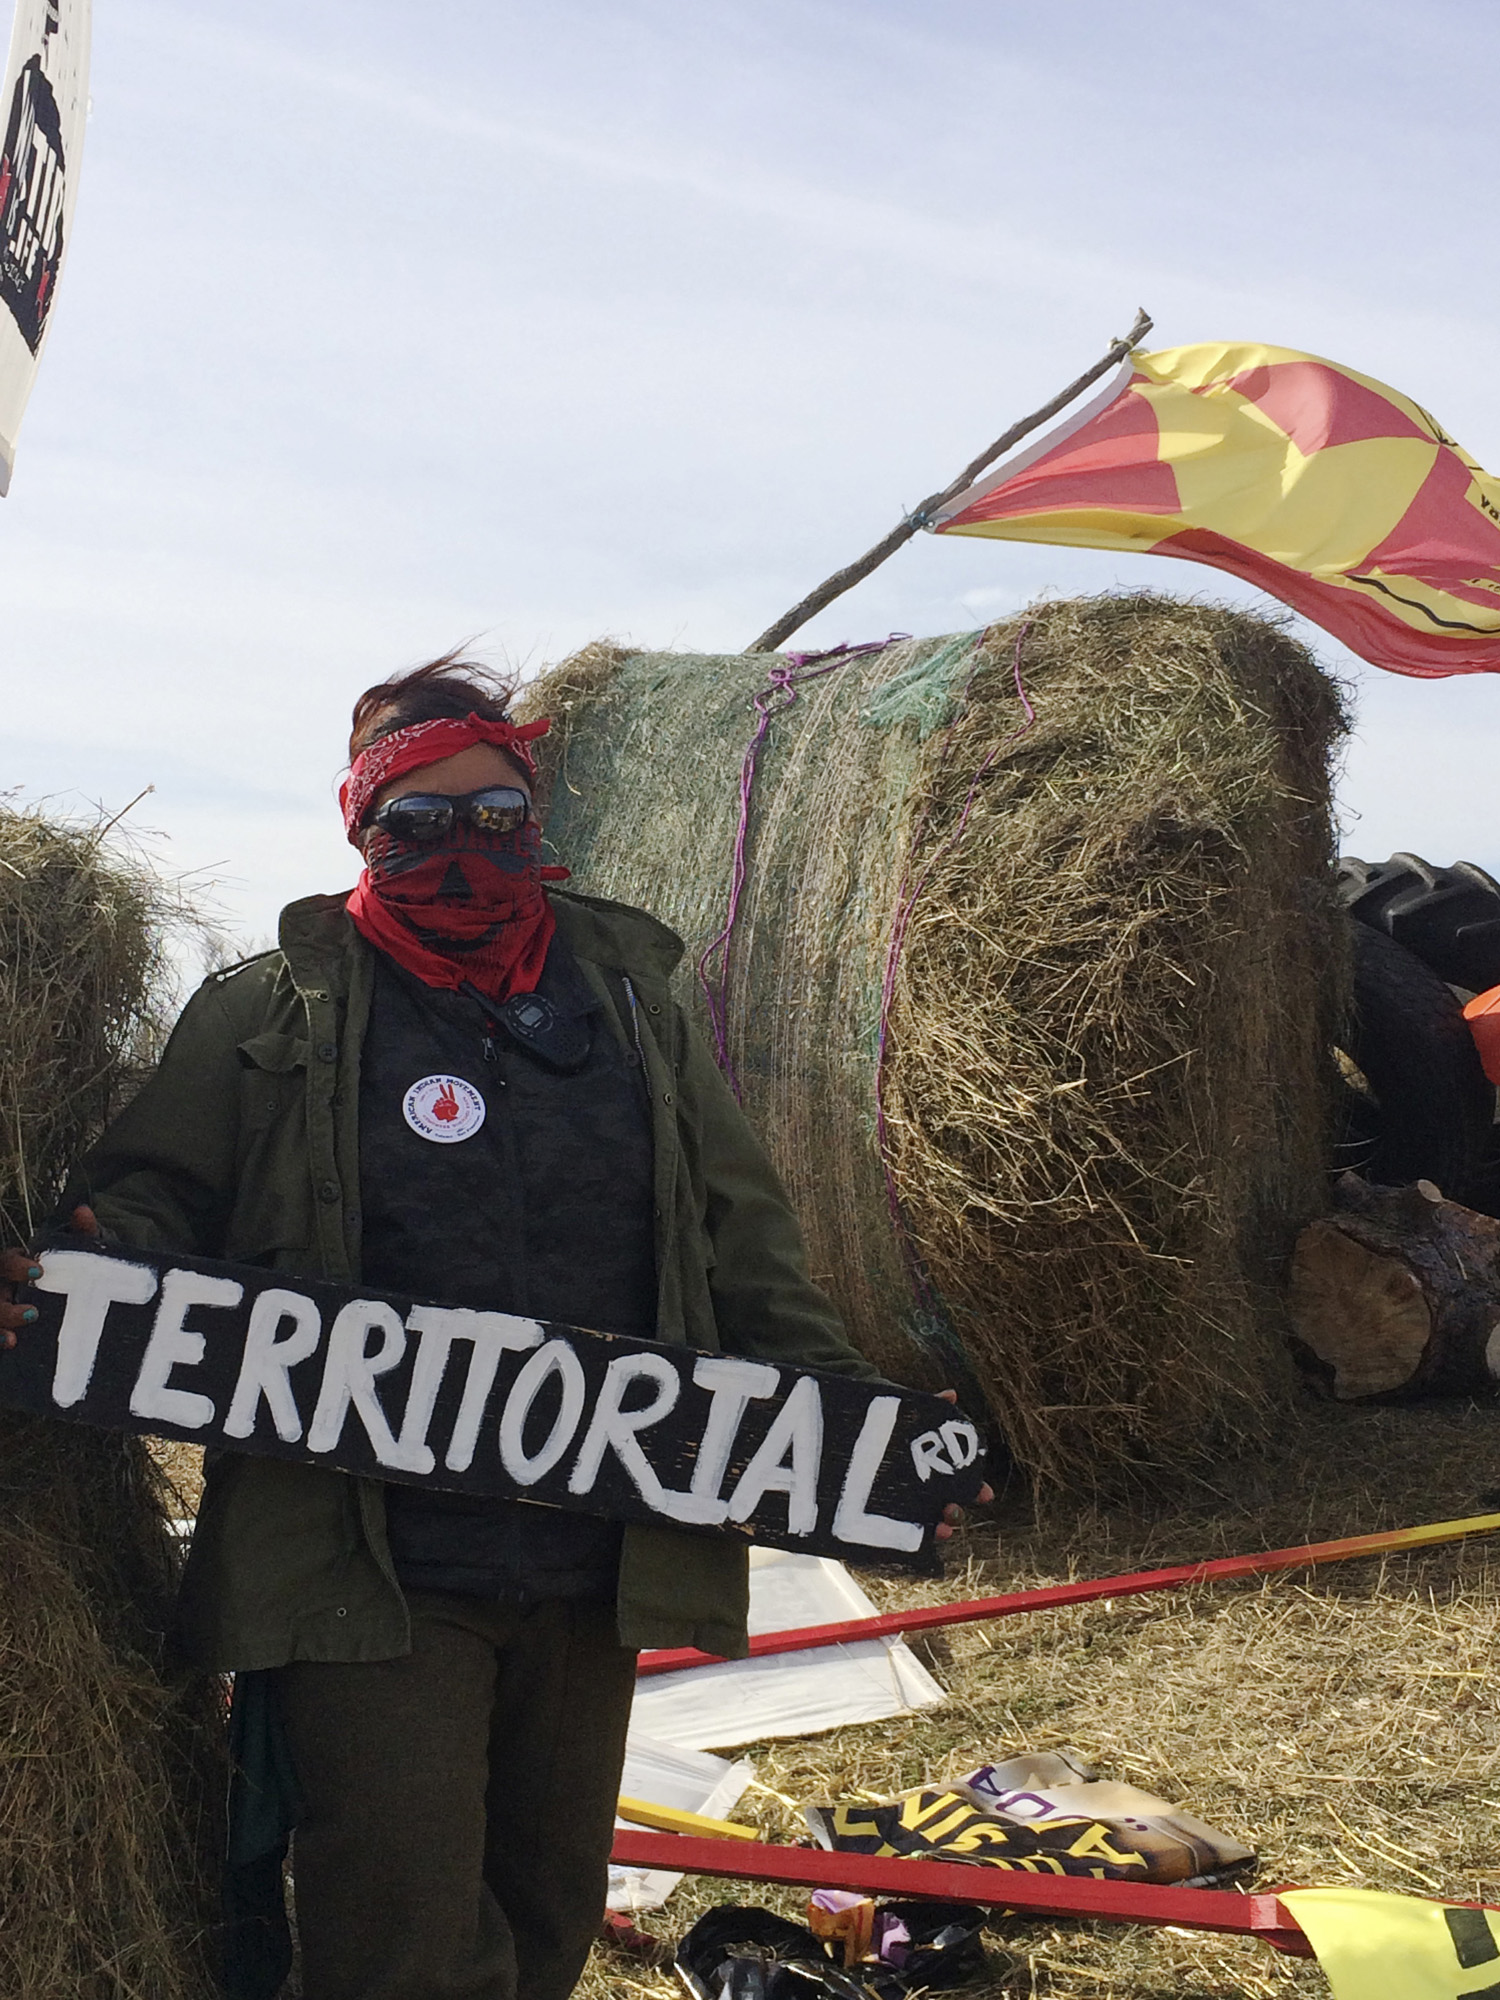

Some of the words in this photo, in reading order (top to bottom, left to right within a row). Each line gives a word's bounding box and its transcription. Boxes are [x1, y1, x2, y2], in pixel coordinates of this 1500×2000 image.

[413, 1078, 442, 1094] INDIAN
[446, 1078, 481, 1111] MOVEMENT
[408, 1096, 433, 1134] AMERICAN
[36, 1250, 925, 1553] TERRITORIAL
[910, 1419, 987, 1484] RD.
